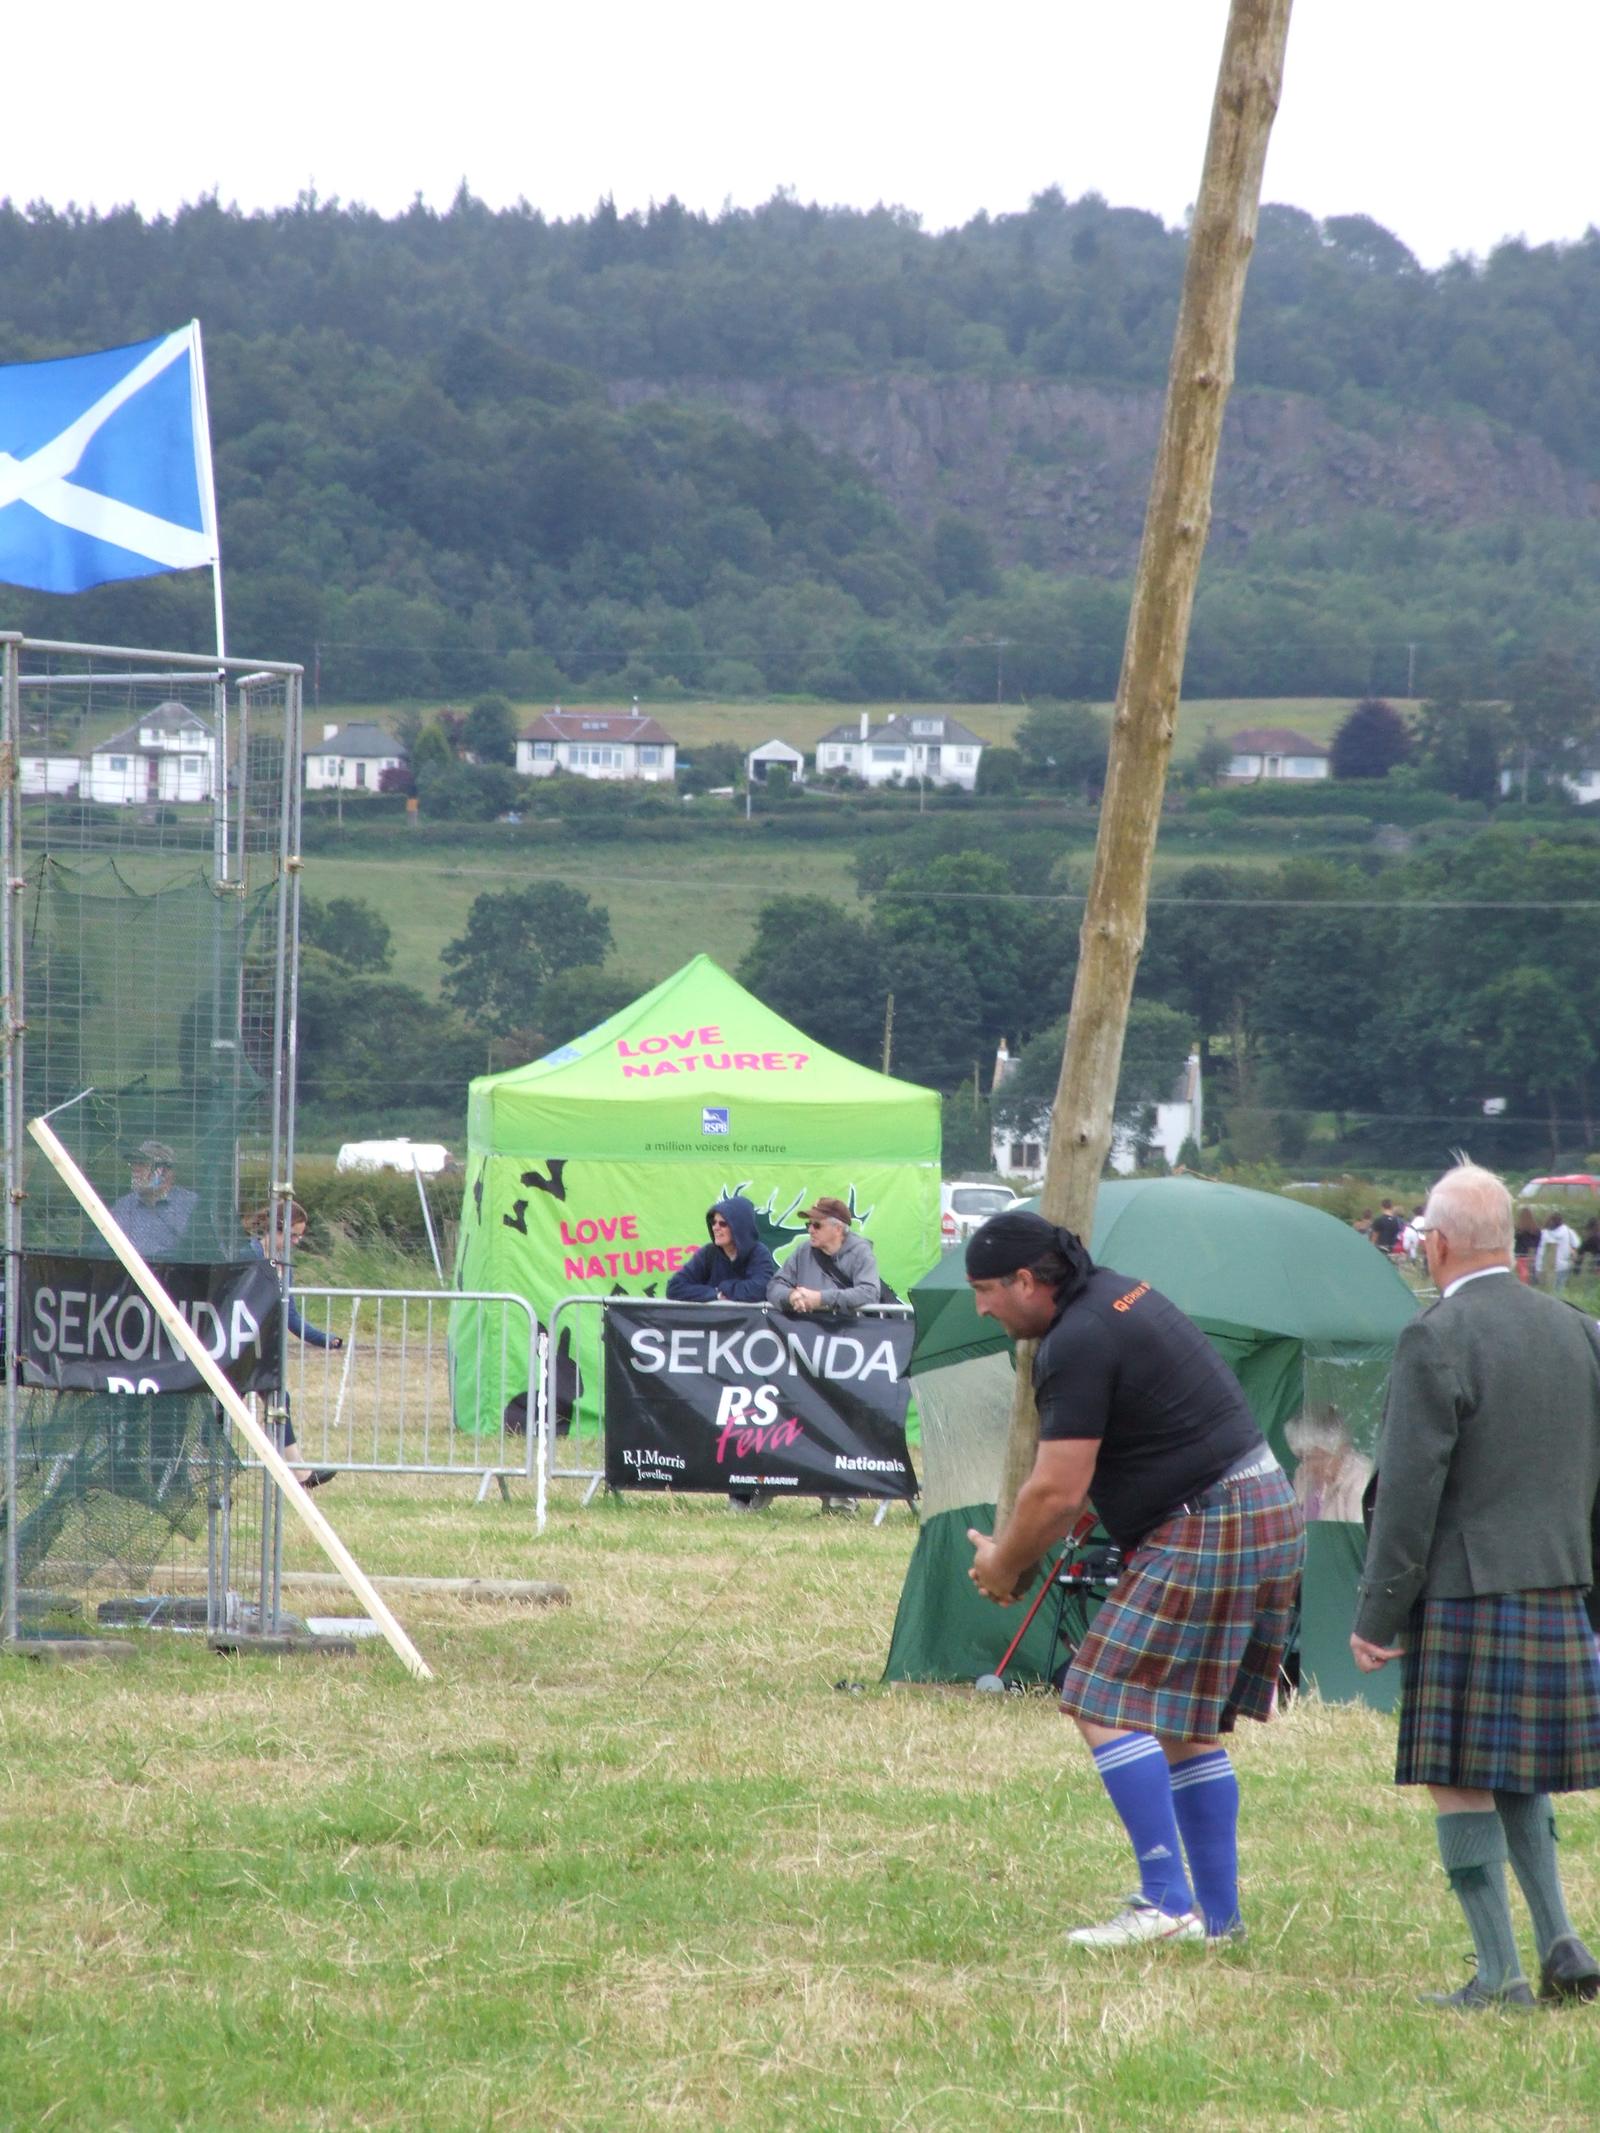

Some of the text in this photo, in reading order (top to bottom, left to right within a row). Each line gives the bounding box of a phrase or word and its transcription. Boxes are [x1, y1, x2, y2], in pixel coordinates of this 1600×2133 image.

[617, 1026, 724, 1056] LOVE
[622, 1052, 810, 1078] NATURE?
[704, 1122, 727, 1133] RSPB
[645, 1141, 786, 1154] a million voices for nature
[560, 1215, 639, 1246] LOVE
[32, 1287, 262, 1362] SEKONDA
[630, 1328, 898, 1384] SEKONDA
[715, 1384, 779, 1426] RS
[715, 1408, 804, 1464] Feva
[637, 1468, 673, 1481] Jewellers
[835, 1455, 906, 1473] Nationals
